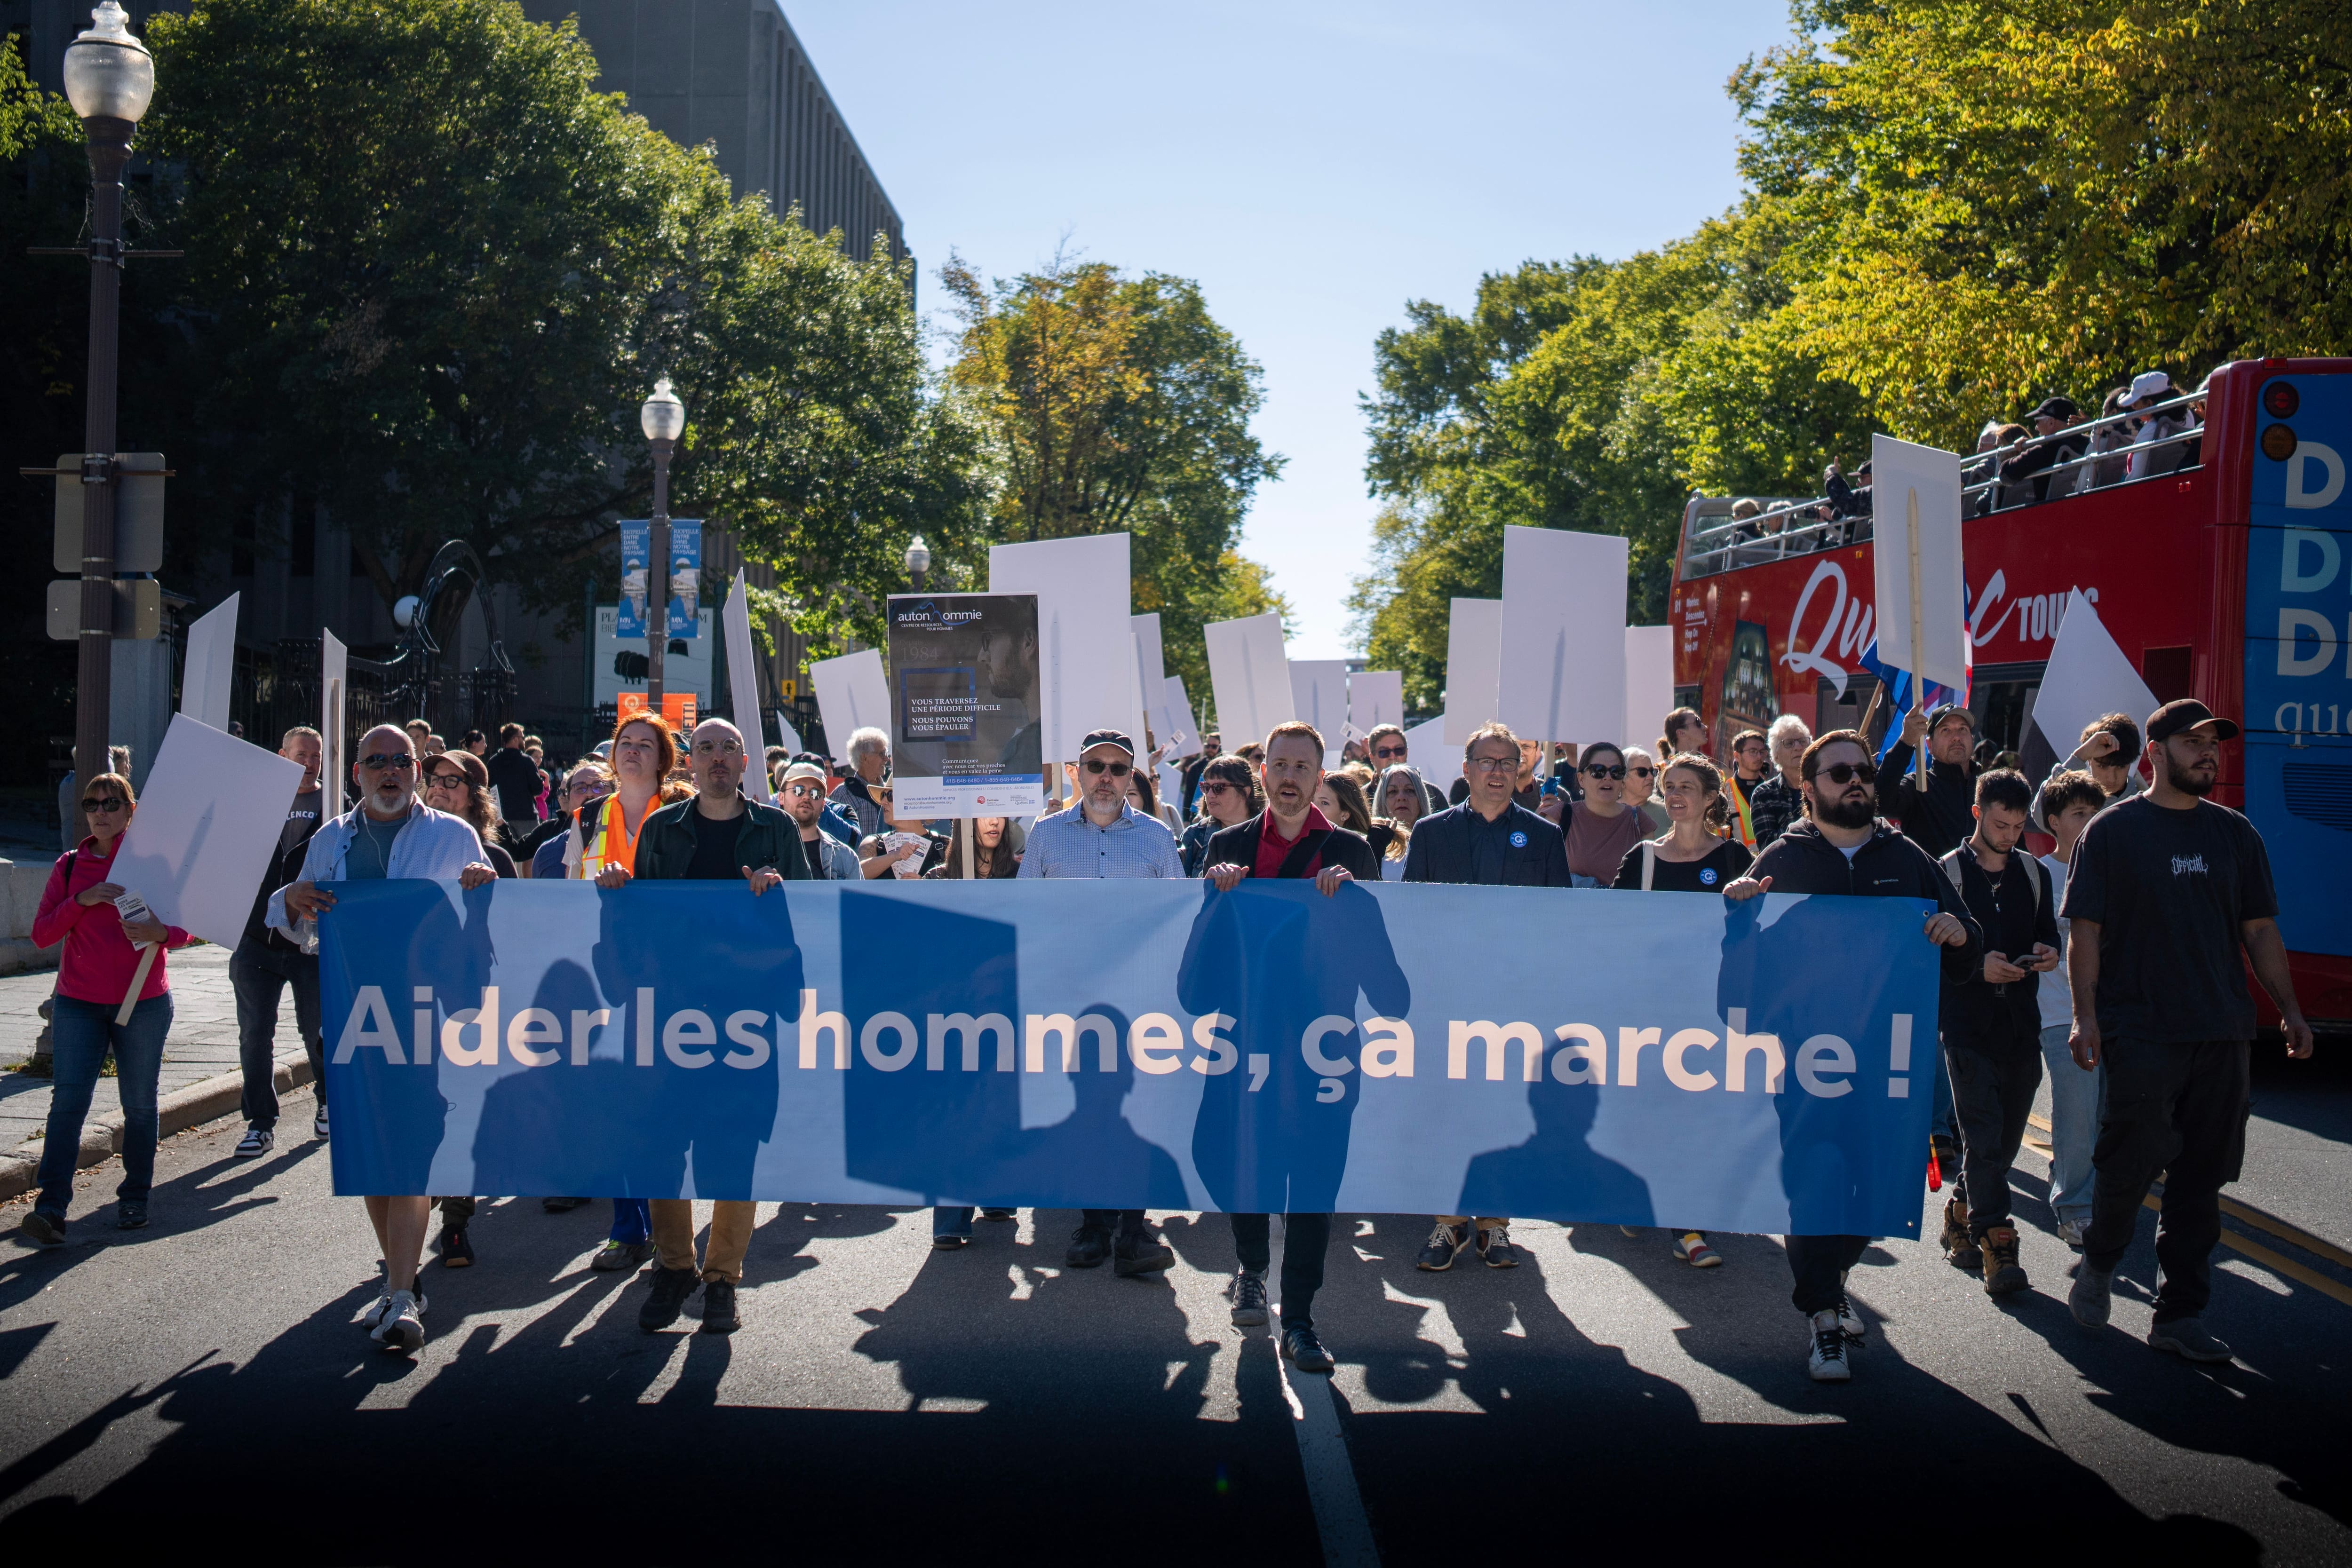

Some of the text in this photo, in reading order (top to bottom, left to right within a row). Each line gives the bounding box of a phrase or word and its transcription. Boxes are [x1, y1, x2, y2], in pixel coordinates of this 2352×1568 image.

[1675, 599, 1681, 613] 81
[1686, 598, 1699, 607] Montez
[1685, 610, 1705, 620] Descendez
[2018, 587, 2098, 642] TOUS
[1693, 628, 1698, 637] On
[900, 647, 939, 661] 1984
[331, 985, 611, 1067] Aider
[636, 986, 771, 1070] les
[798, 988, 1271, 1092] hommes,
[1301, 1013, 1414, 1103] ça
[1447, 1007, 1858, 1099] marche
